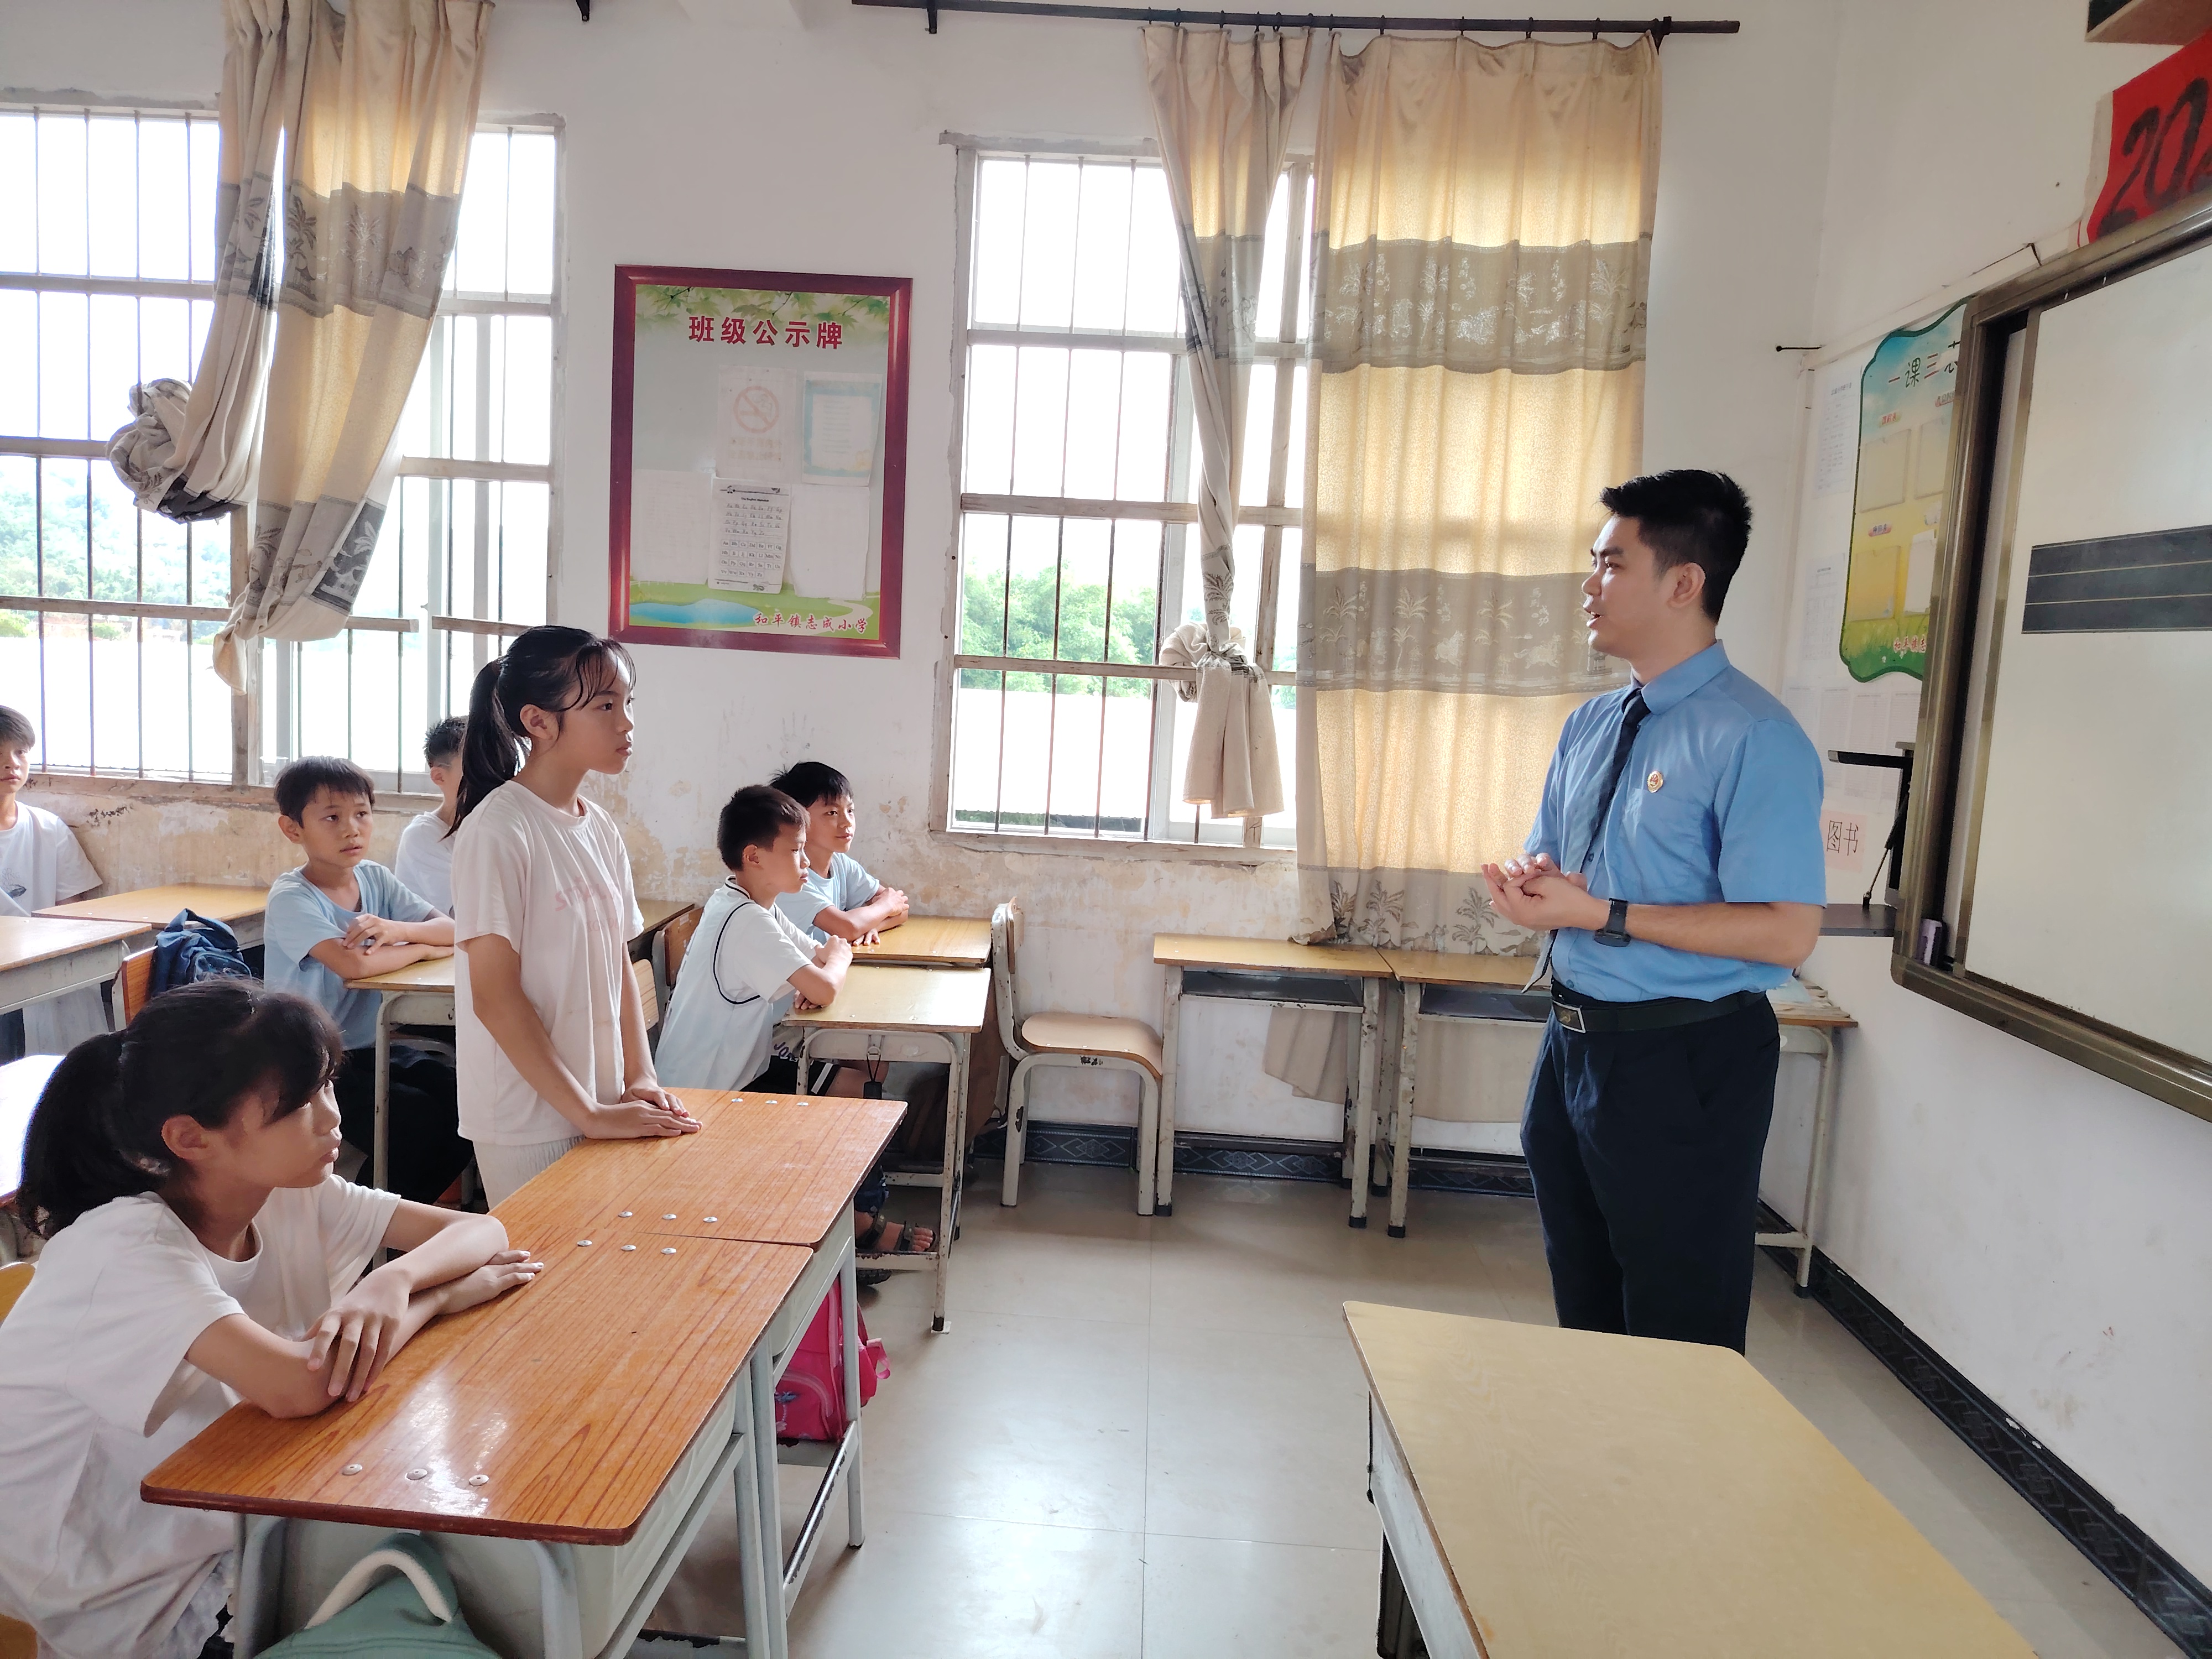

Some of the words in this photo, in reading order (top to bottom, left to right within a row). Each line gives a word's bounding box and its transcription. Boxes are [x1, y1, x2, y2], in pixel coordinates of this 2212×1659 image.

[688, 315, 843, 349] 班级公示牌
[754, 612, 868, 634] 和平镇志成小学
[1827, 820, 1859, 856] 图书
